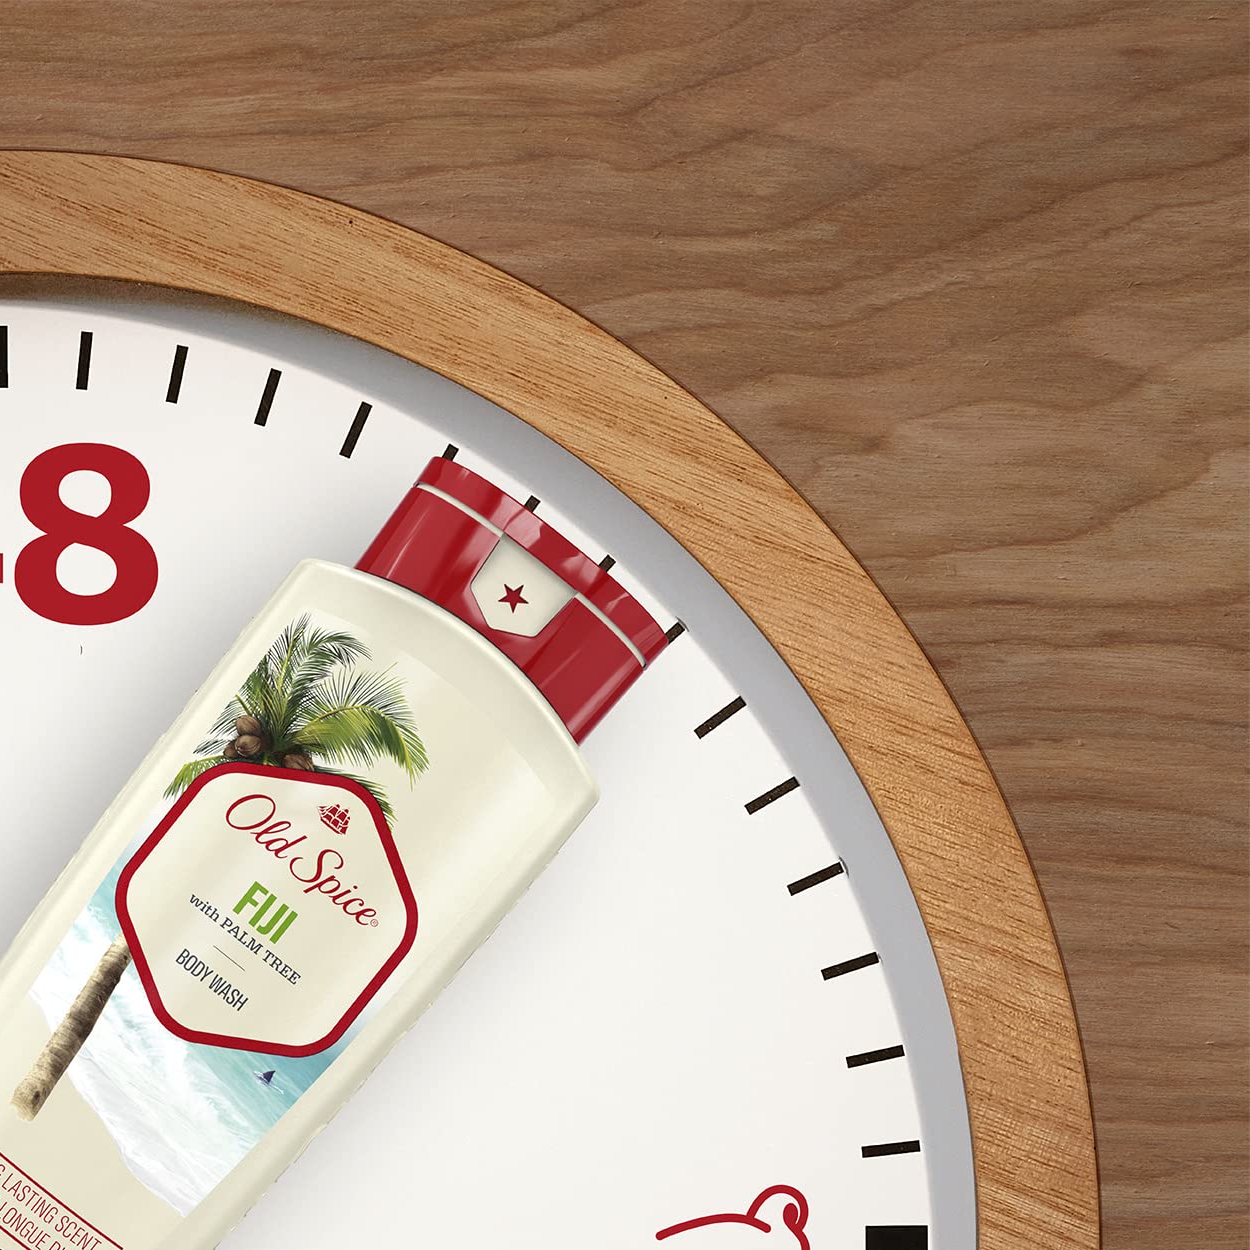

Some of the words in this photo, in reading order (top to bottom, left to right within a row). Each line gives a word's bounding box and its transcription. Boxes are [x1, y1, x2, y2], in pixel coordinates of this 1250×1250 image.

[225, 793, 307, 859] Old
[189, 893, 220, 921] with
[220, 919, 262, 956] PALM
[261, 949, 301, 984] TREE
[233, 881, 298, 943] FIJI
[175, 948, 213, 988] BODY
[208, 977, 248, 1011] WASH
[2, 1173, 58, 1224] LASTING
